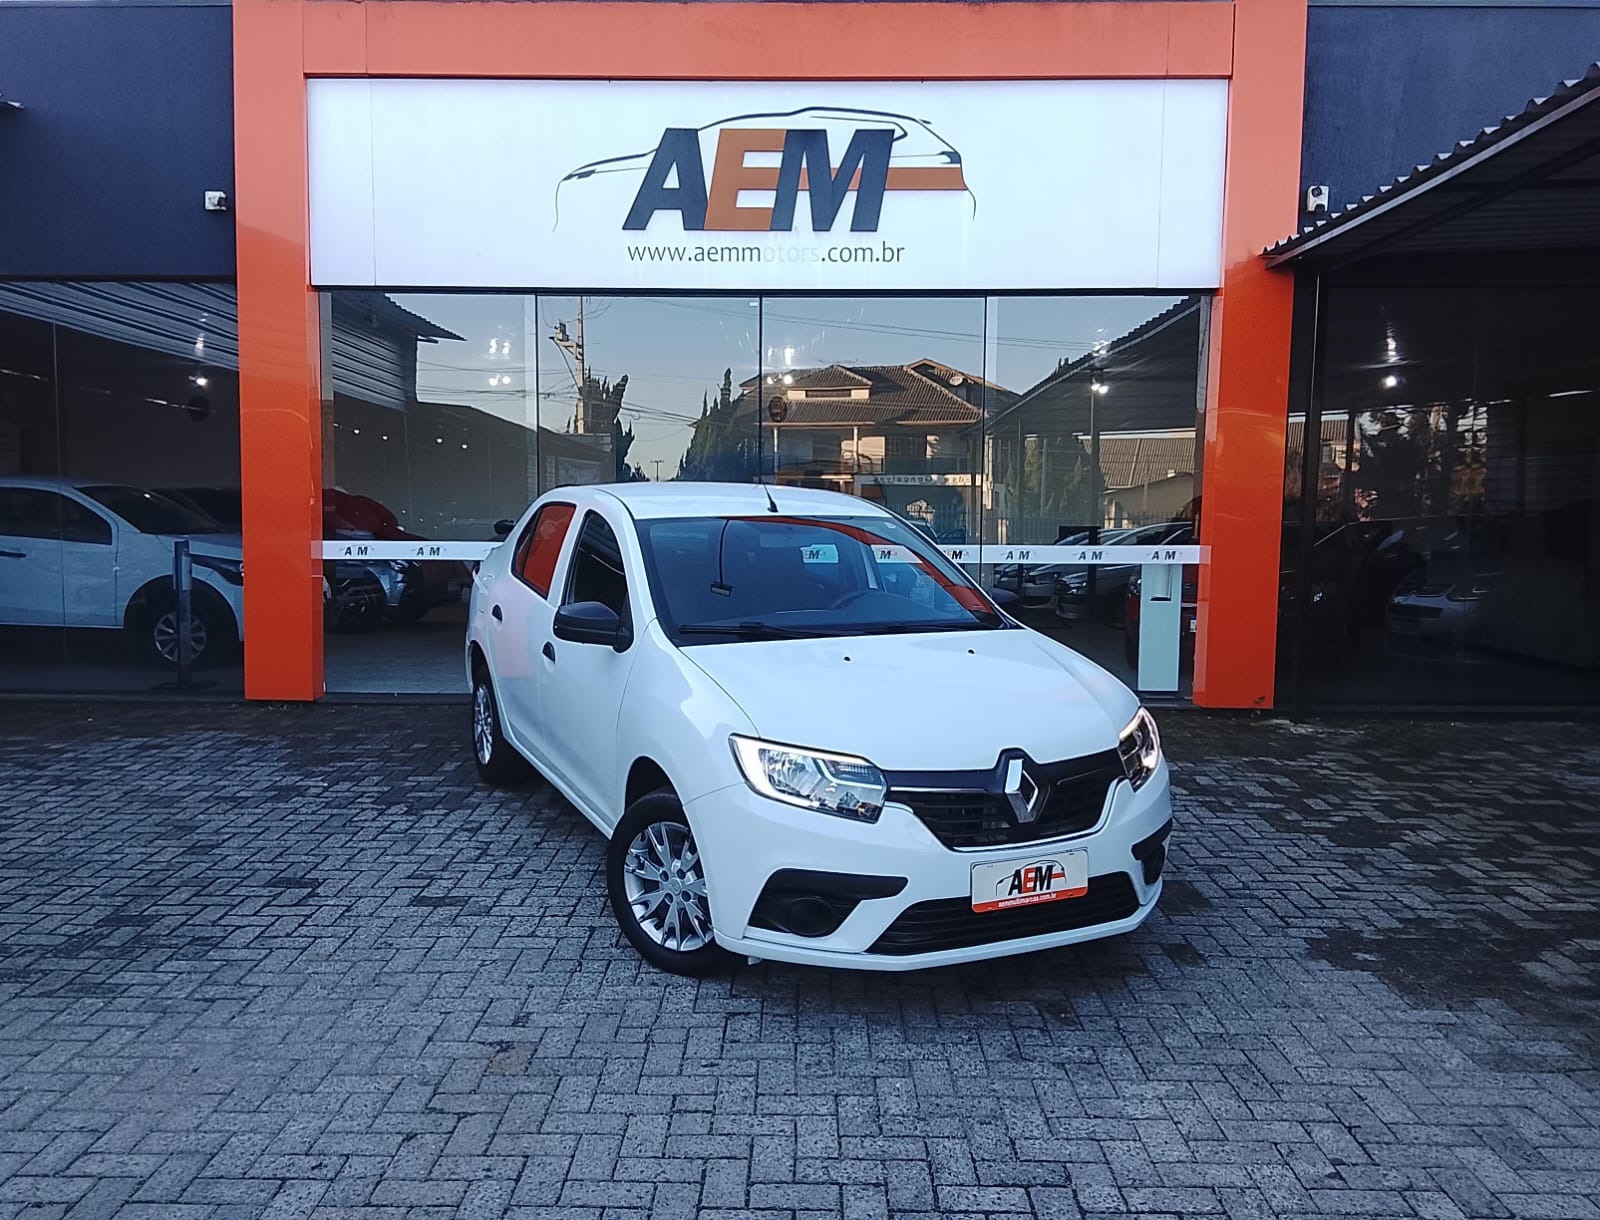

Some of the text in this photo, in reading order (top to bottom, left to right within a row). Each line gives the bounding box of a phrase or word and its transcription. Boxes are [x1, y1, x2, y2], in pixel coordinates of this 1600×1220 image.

[622, 127, 896, 232] AEM
[627, 241, 905, 263] www.aemmotors.com.br
[1008, 864, 1055, 897] AEM
